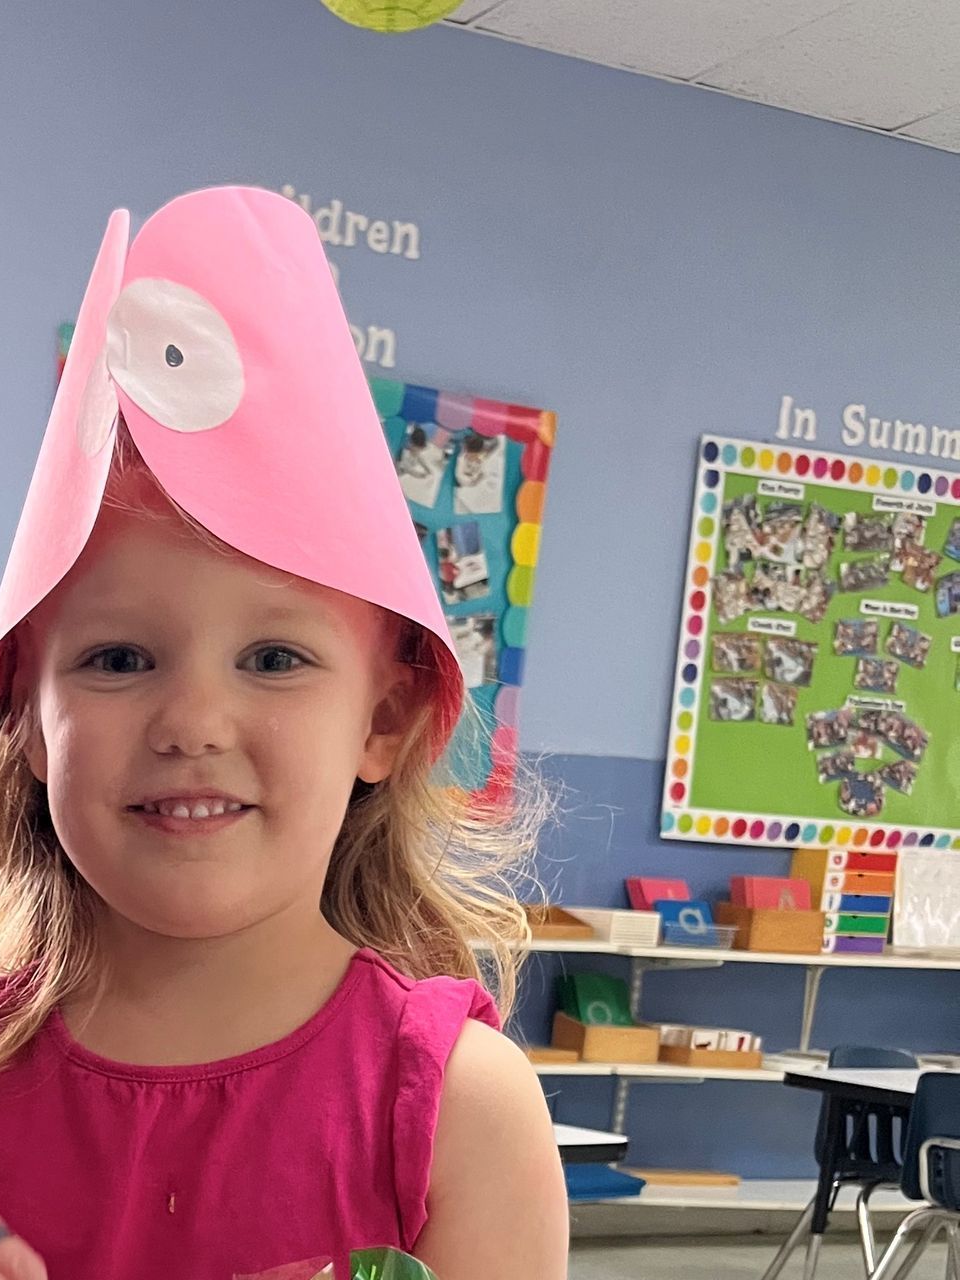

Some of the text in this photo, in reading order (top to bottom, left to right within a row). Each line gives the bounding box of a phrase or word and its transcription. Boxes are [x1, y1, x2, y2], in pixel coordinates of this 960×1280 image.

[282, 184, 420, 260] dren
[776, 395, 960, 462] In Summ
